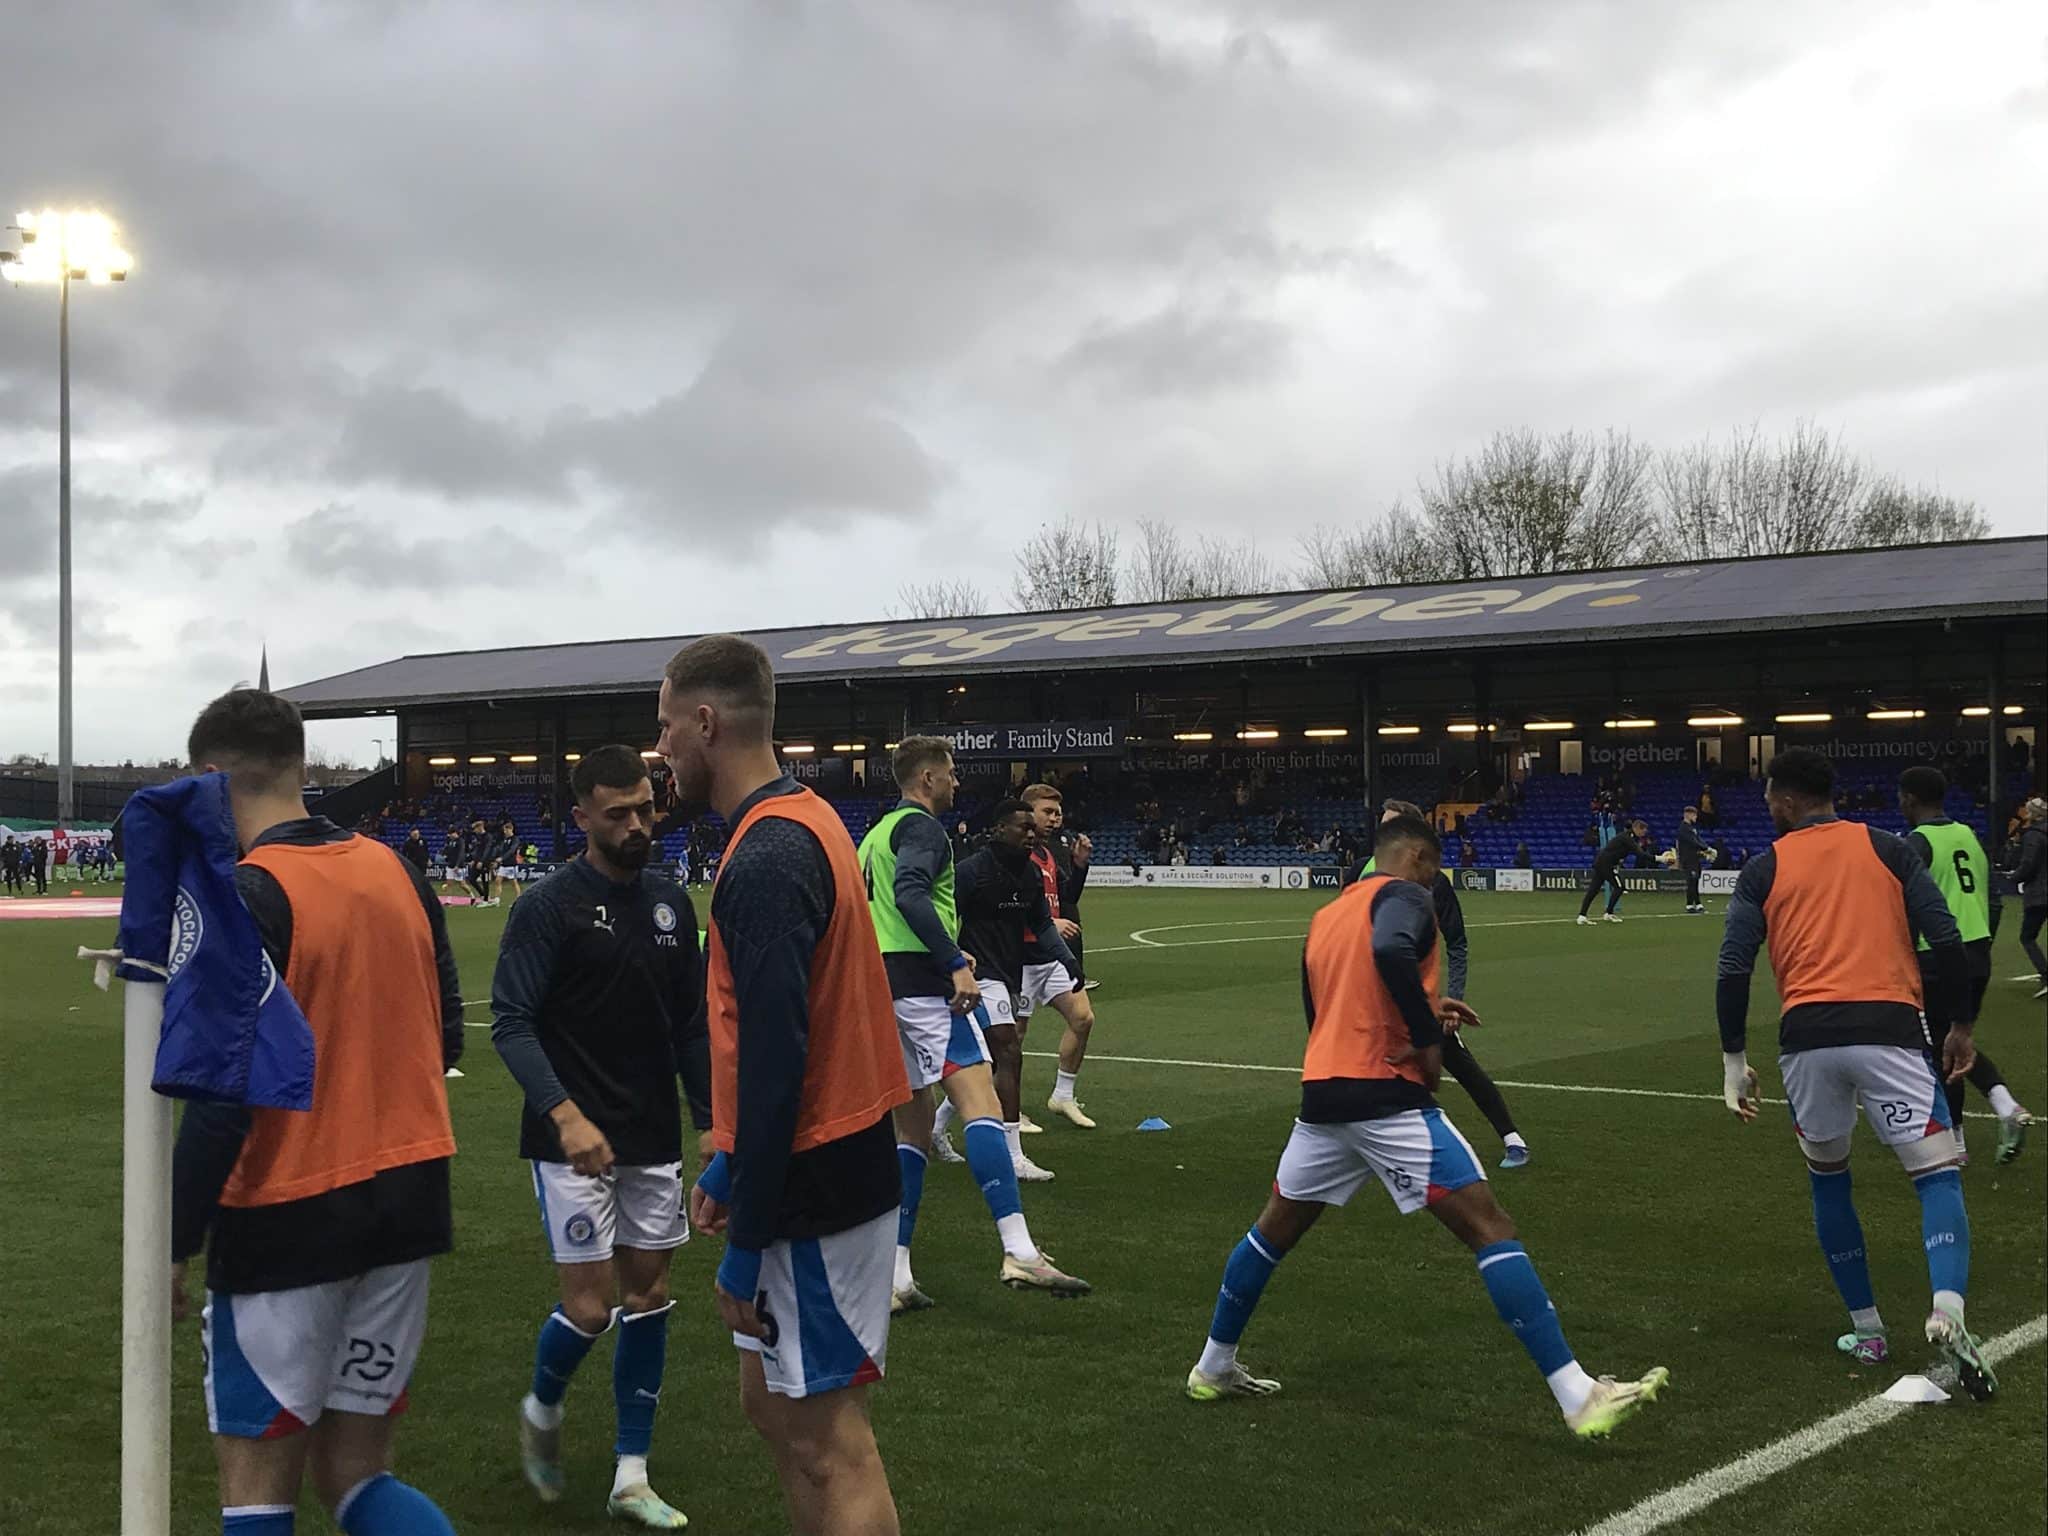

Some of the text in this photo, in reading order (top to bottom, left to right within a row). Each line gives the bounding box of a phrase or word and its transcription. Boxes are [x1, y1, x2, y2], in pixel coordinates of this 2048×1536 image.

[781, 578, 1650, 666] together.
[1007, 729, 1062, 752] Family
[1066, 727, 1113, 748] Stand
[1381, 747, 1440, 768] normal
[1312, 874, 1339, 886] VITA
[1703, 873, 1738, 888] Pare
[1953, 850, 1975, 893] 6
[654, 934, 678, 947] VITA
